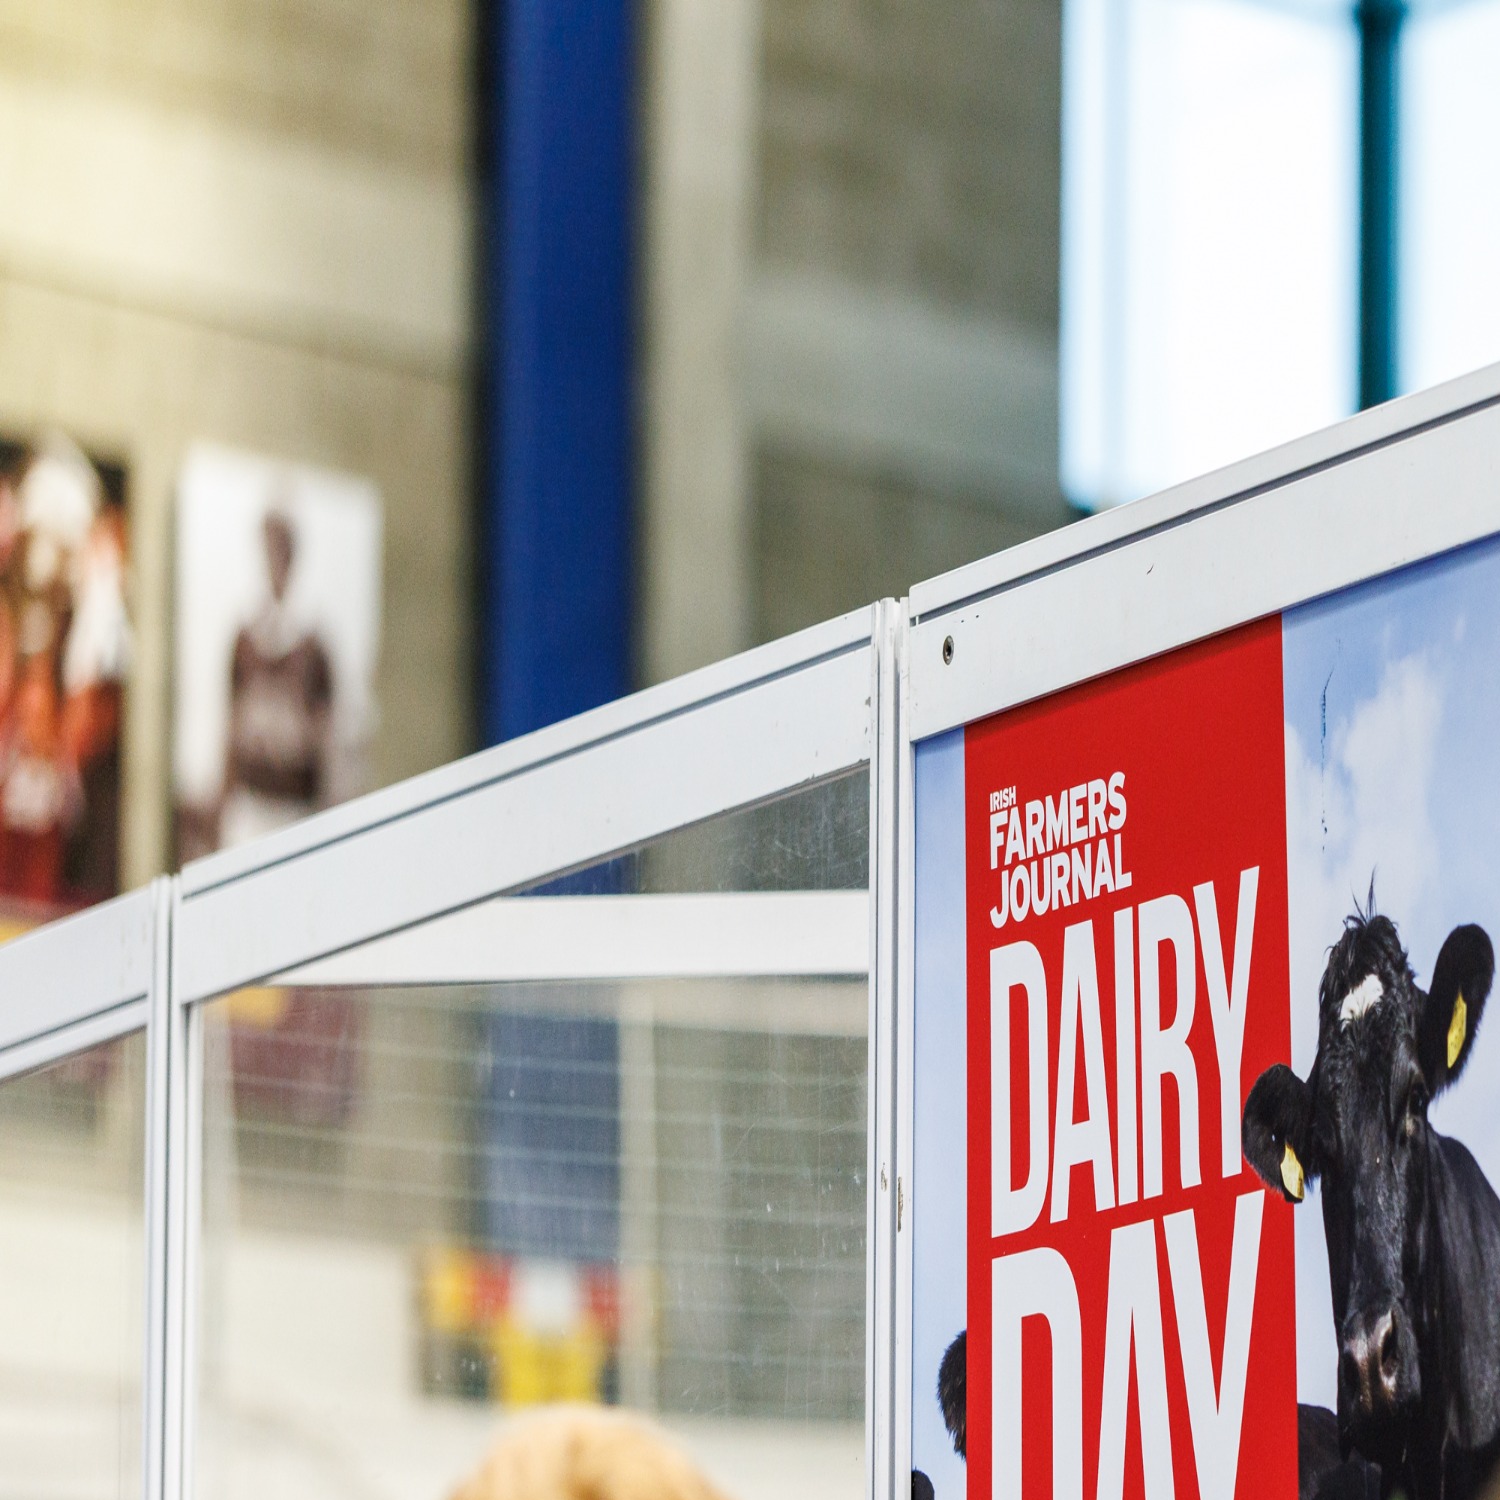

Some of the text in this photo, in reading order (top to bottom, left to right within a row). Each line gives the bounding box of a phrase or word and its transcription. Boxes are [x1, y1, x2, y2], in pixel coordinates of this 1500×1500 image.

[989, 785, 1017, 813] IRISH
[989, 771, 1127, 870] FARMERS
[989, 832, 1133, 929] JOURNAL
[990, 865, 1260, 1238] DAIRY
